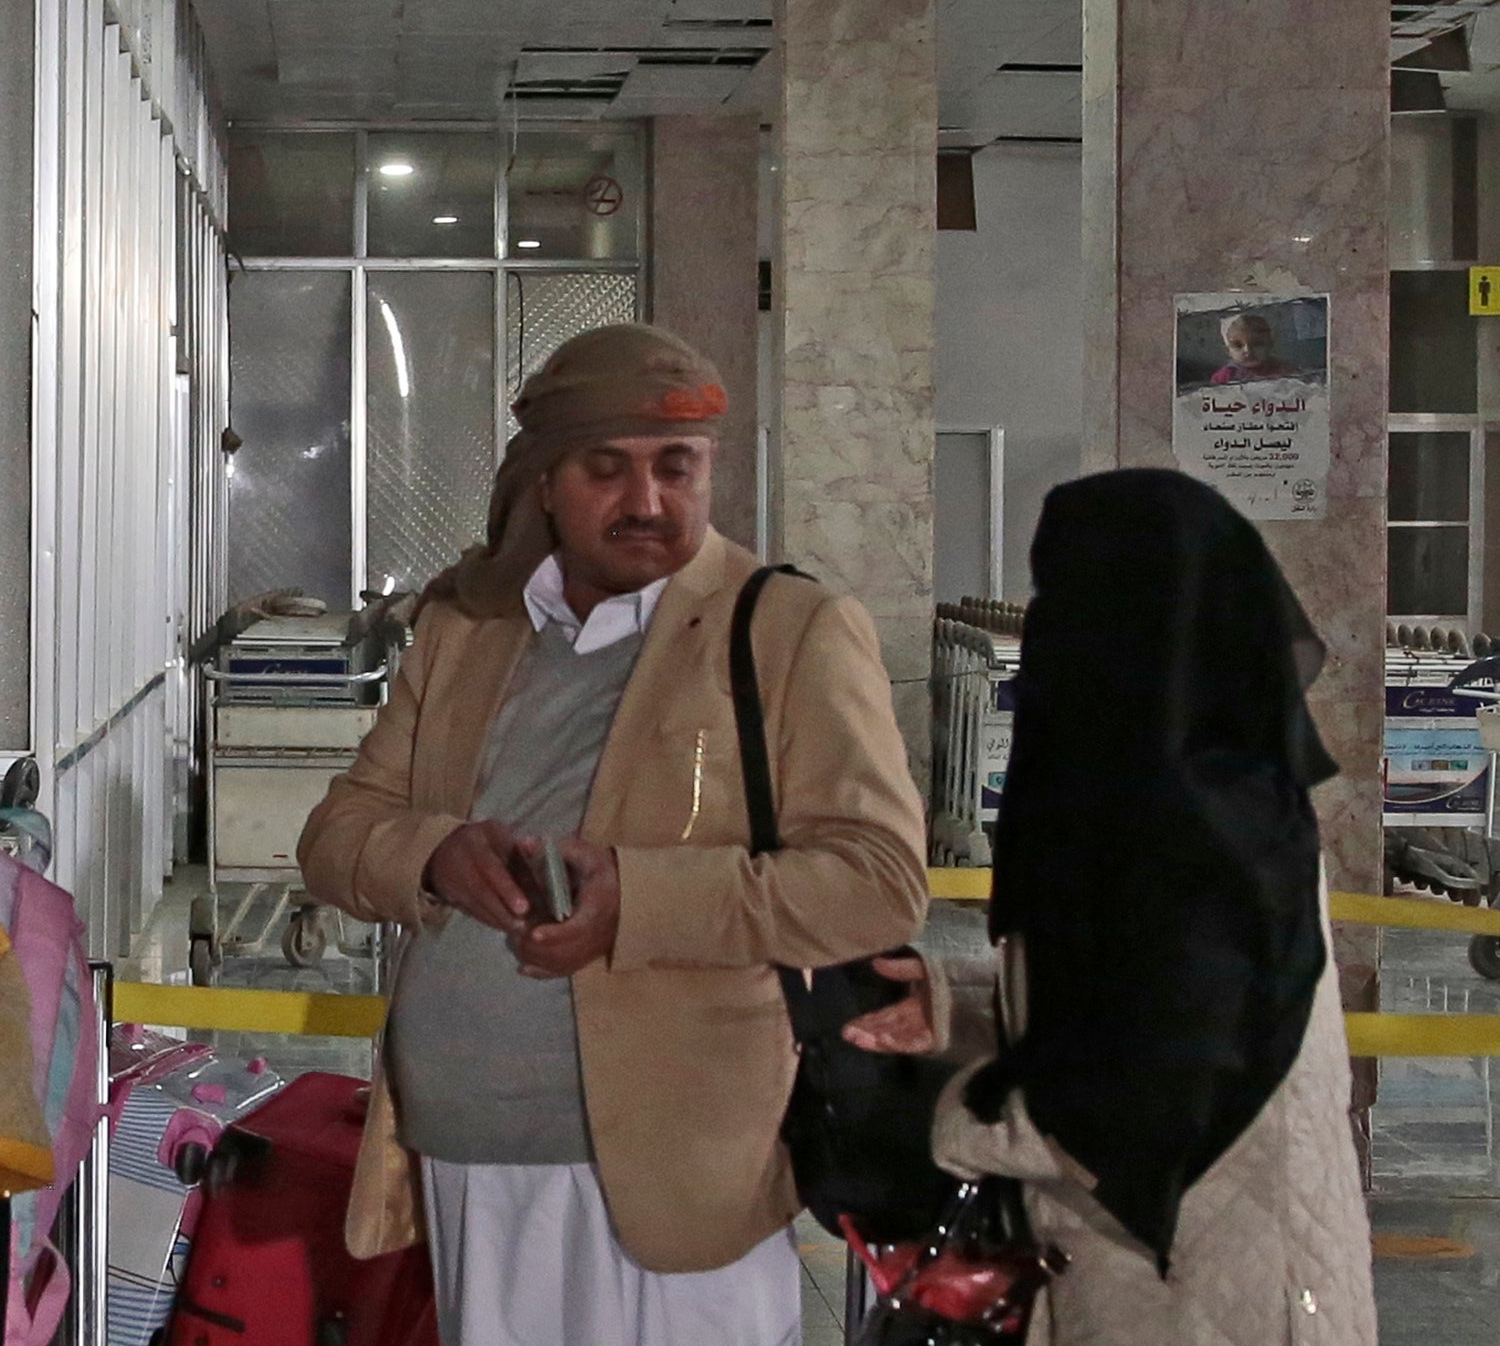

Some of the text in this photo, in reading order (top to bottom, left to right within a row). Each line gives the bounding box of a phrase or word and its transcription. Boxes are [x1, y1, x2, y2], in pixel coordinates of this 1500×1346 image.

[1202, 397, 1305, 417] الدواء حياة
[1203, 421, 1236, 432] صنعاء
[1237, 422, 1264, 432] مطار
[1213, 438, 1292, 451] ليصل الدواء
